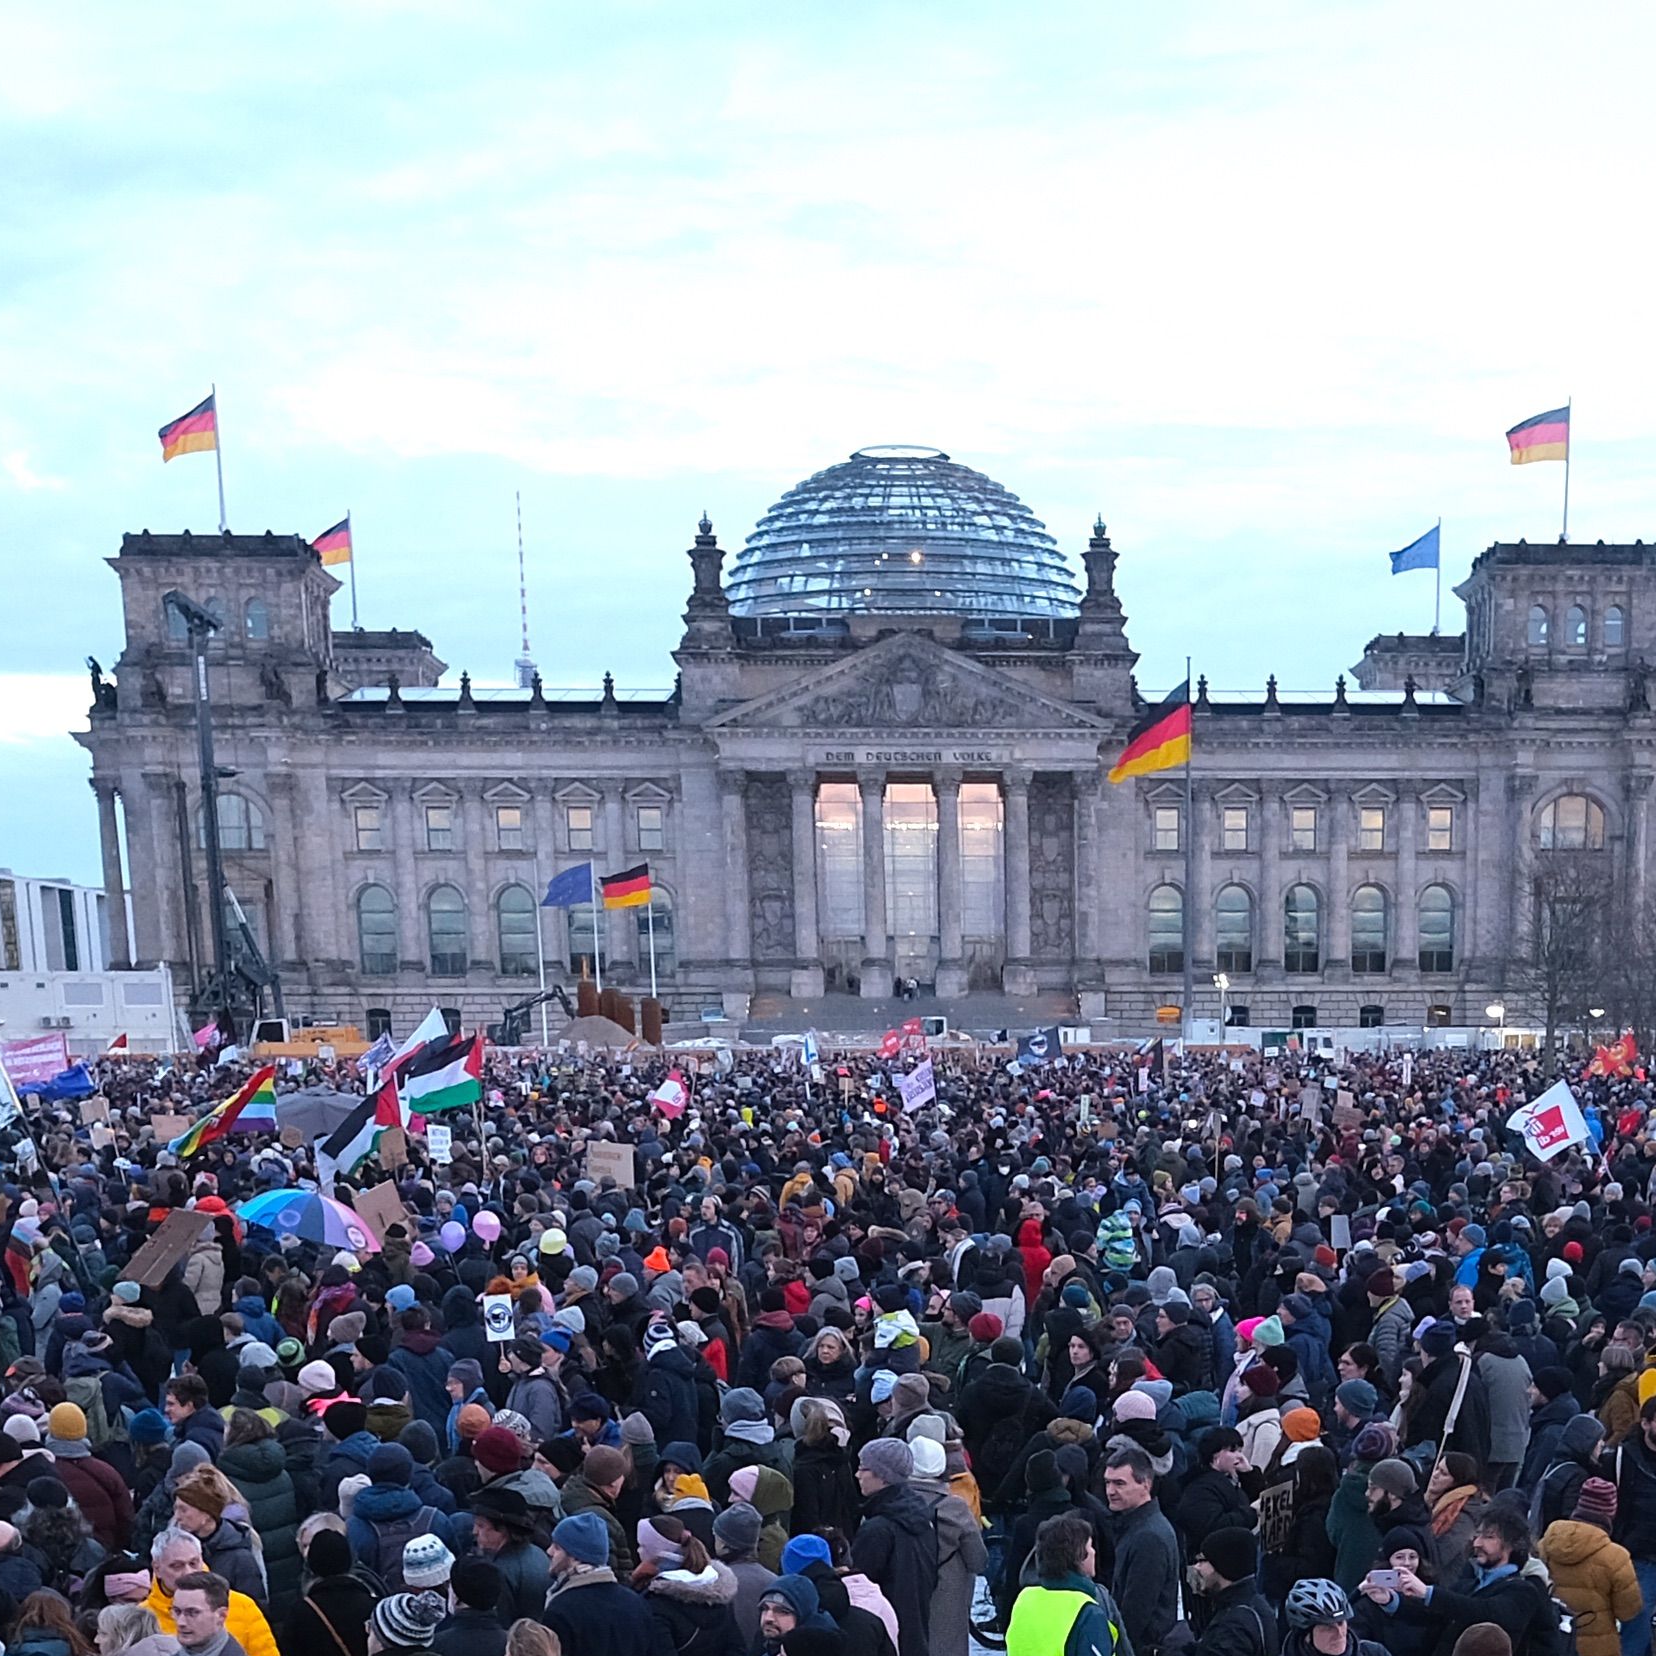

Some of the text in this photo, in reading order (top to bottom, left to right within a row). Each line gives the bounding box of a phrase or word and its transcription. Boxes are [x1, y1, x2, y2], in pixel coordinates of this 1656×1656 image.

[825, 751, 992, 762] DEM DEUTSCHEN VOLKE
